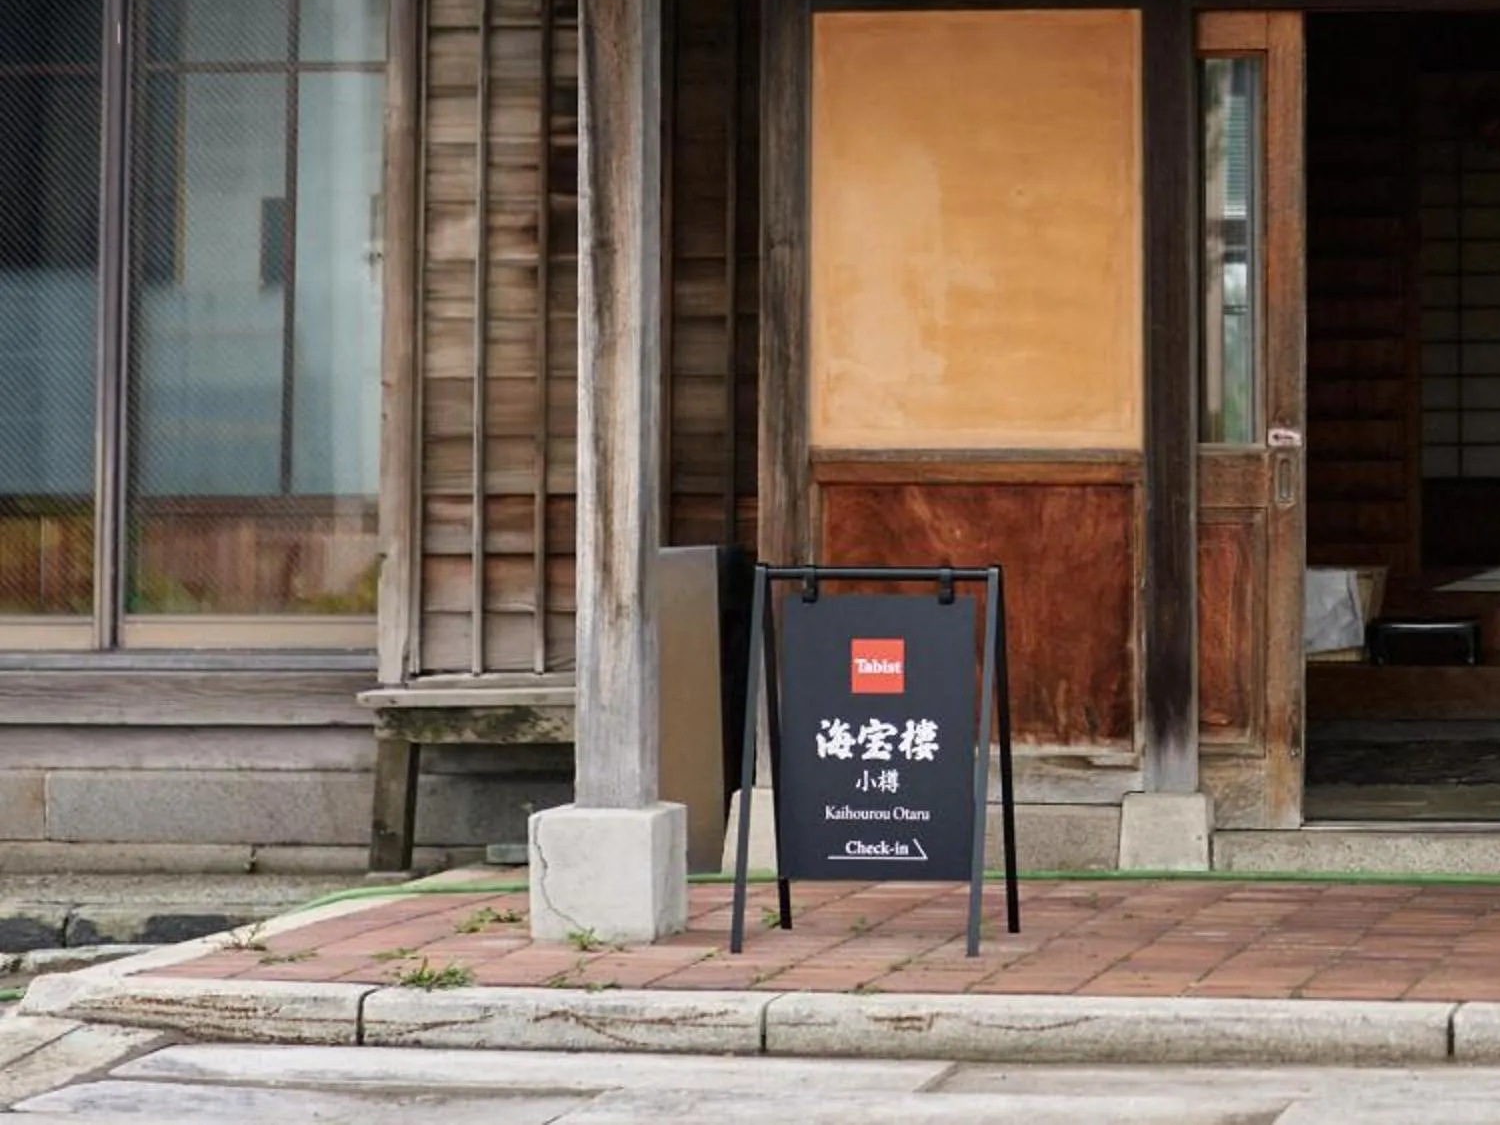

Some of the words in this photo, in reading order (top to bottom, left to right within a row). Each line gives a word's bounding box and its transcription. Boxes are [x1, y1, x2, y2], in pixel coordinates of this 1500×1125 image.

[854, 657, 903, 675] Tabist
[815, 717, 940, 761] 海宝樓
[855, 768, 900, 794] 小樽
[825, 804, 891, 821] Kaihourou
[892, 805, 931, 821] Otaru
[845, 840, 909, 855] Check-in
